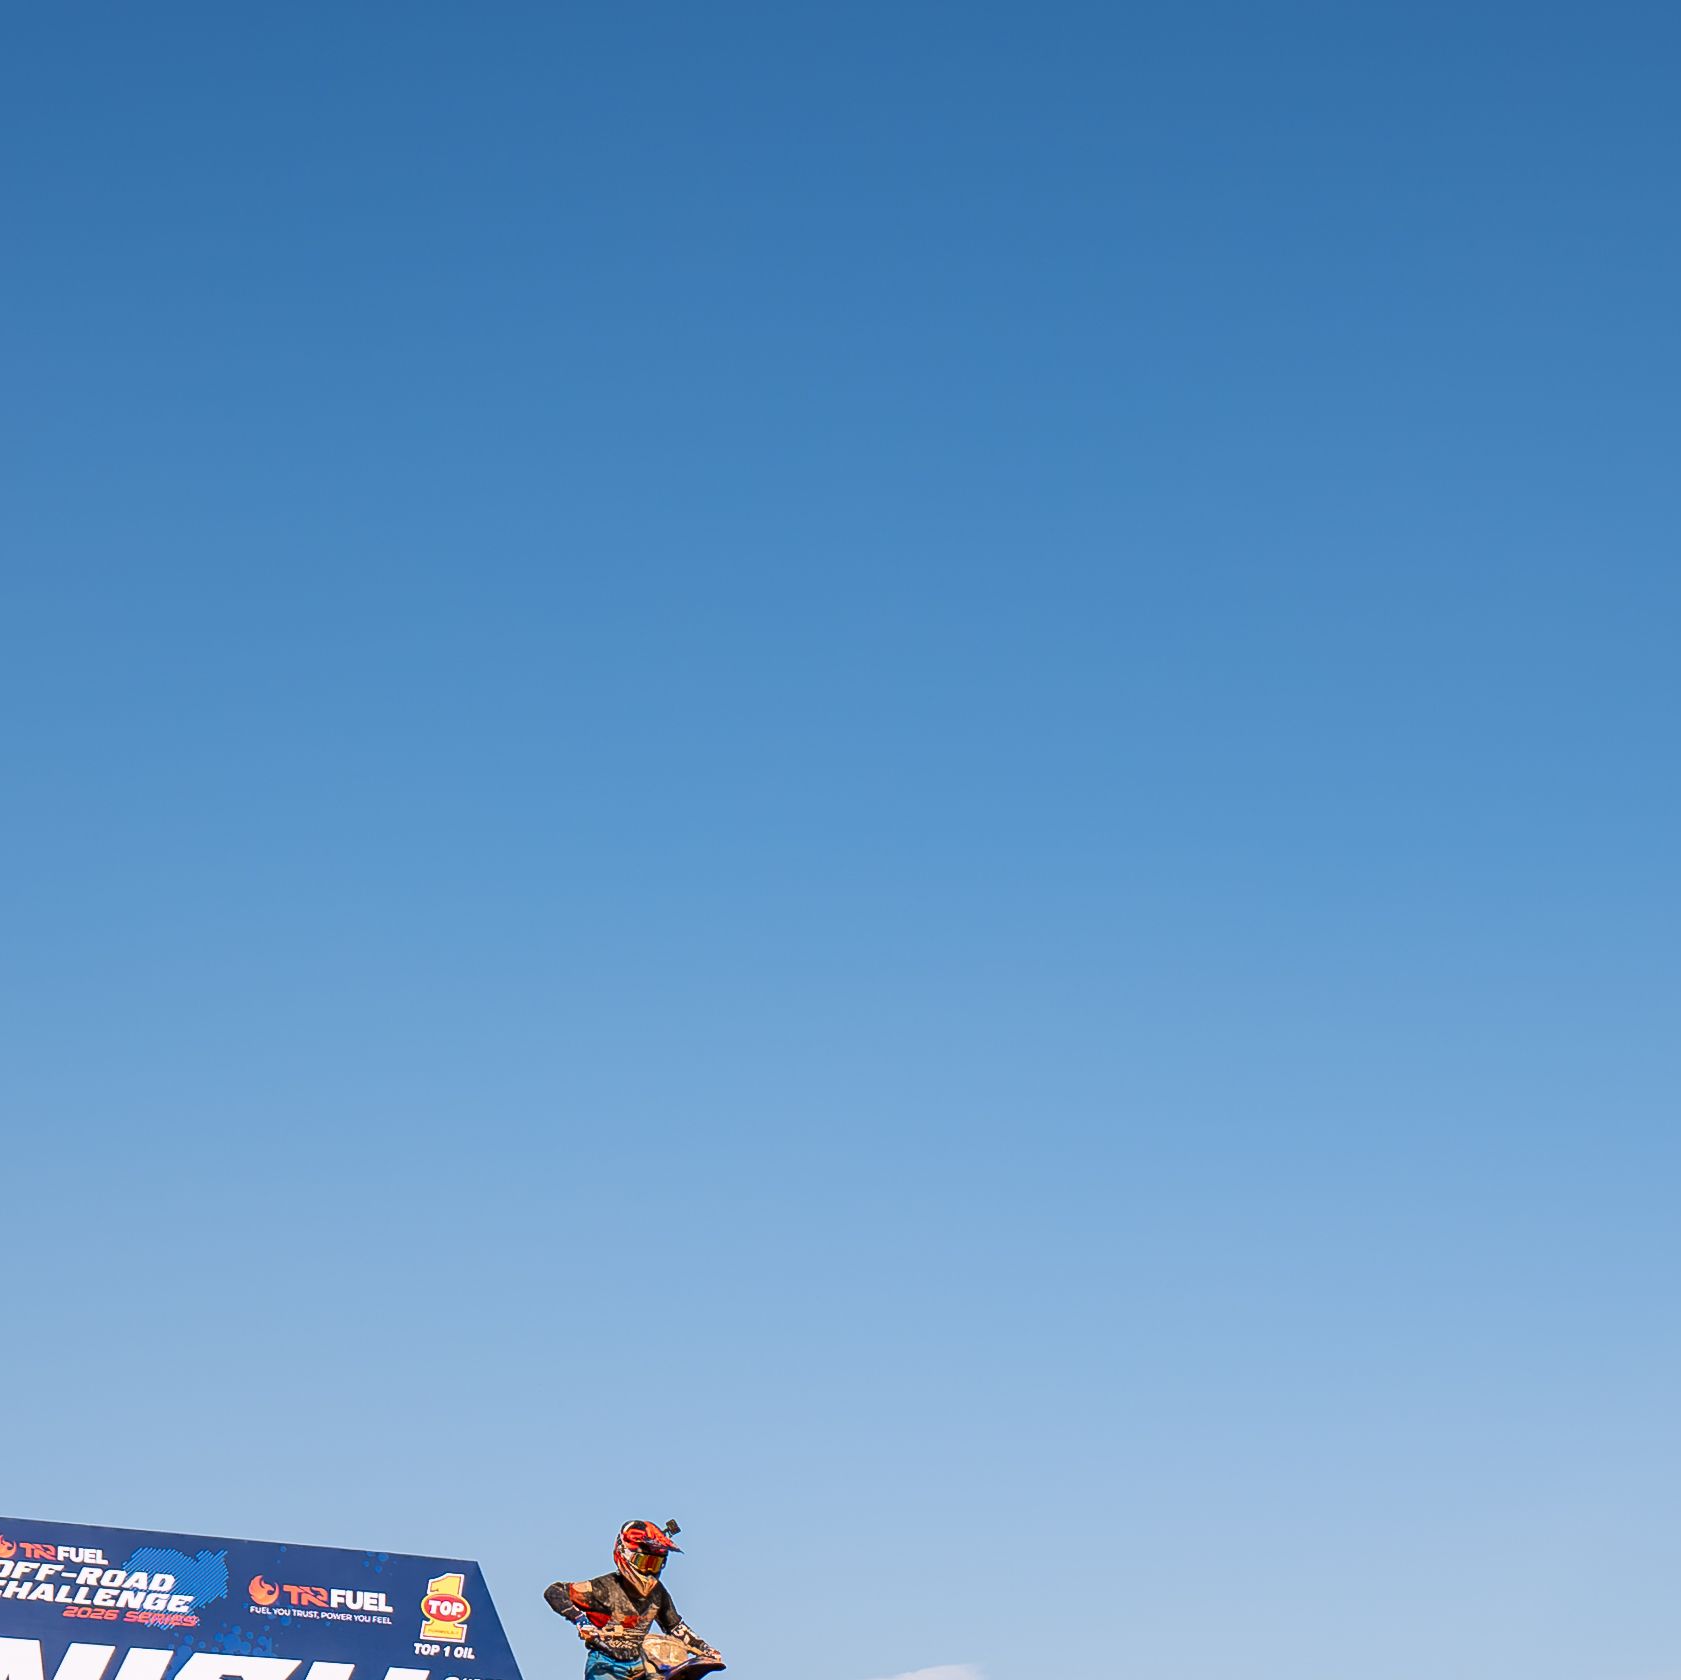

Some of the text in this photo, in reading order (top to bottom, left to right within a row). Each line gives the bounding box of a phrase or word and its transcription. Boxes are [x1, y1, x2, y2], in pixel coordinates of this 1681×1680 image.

[63, 1606, 200, 1627] 2026 SERIES
[250, 1606, 392, 1625] FUEL YOU TRUST, POWER YOU FEEL
[427, 1600, 465, 1616] TOP
[414, 1643, 475, 1659] TOP 1 OIL
